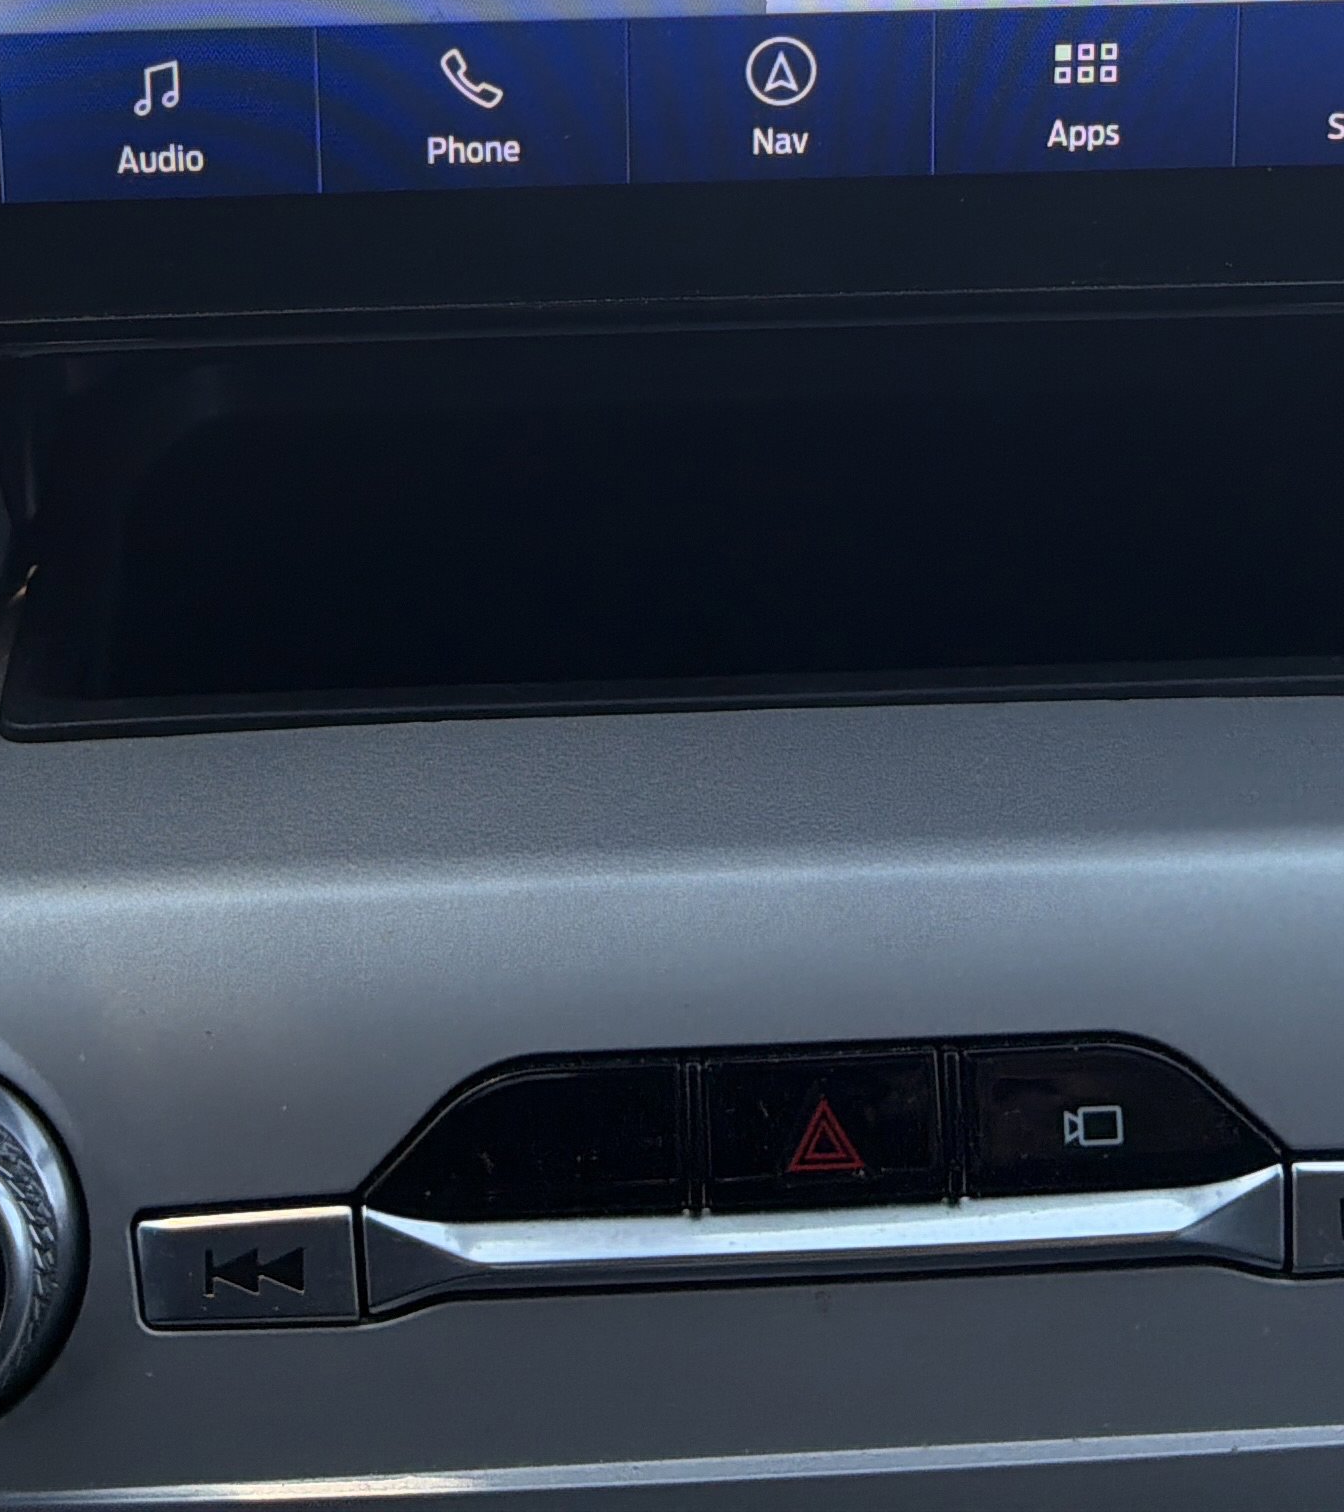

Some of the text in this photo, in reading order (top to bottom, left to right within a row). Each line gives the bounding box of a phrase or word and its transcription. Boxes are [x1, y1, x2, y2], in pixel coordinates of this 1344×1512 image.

[752, 128, 810, 157] Nav
[1047, 117, 1121, 151] Apps
[117, 143, 205, 176] Audio
[426, 135, 522, 167] Phone
